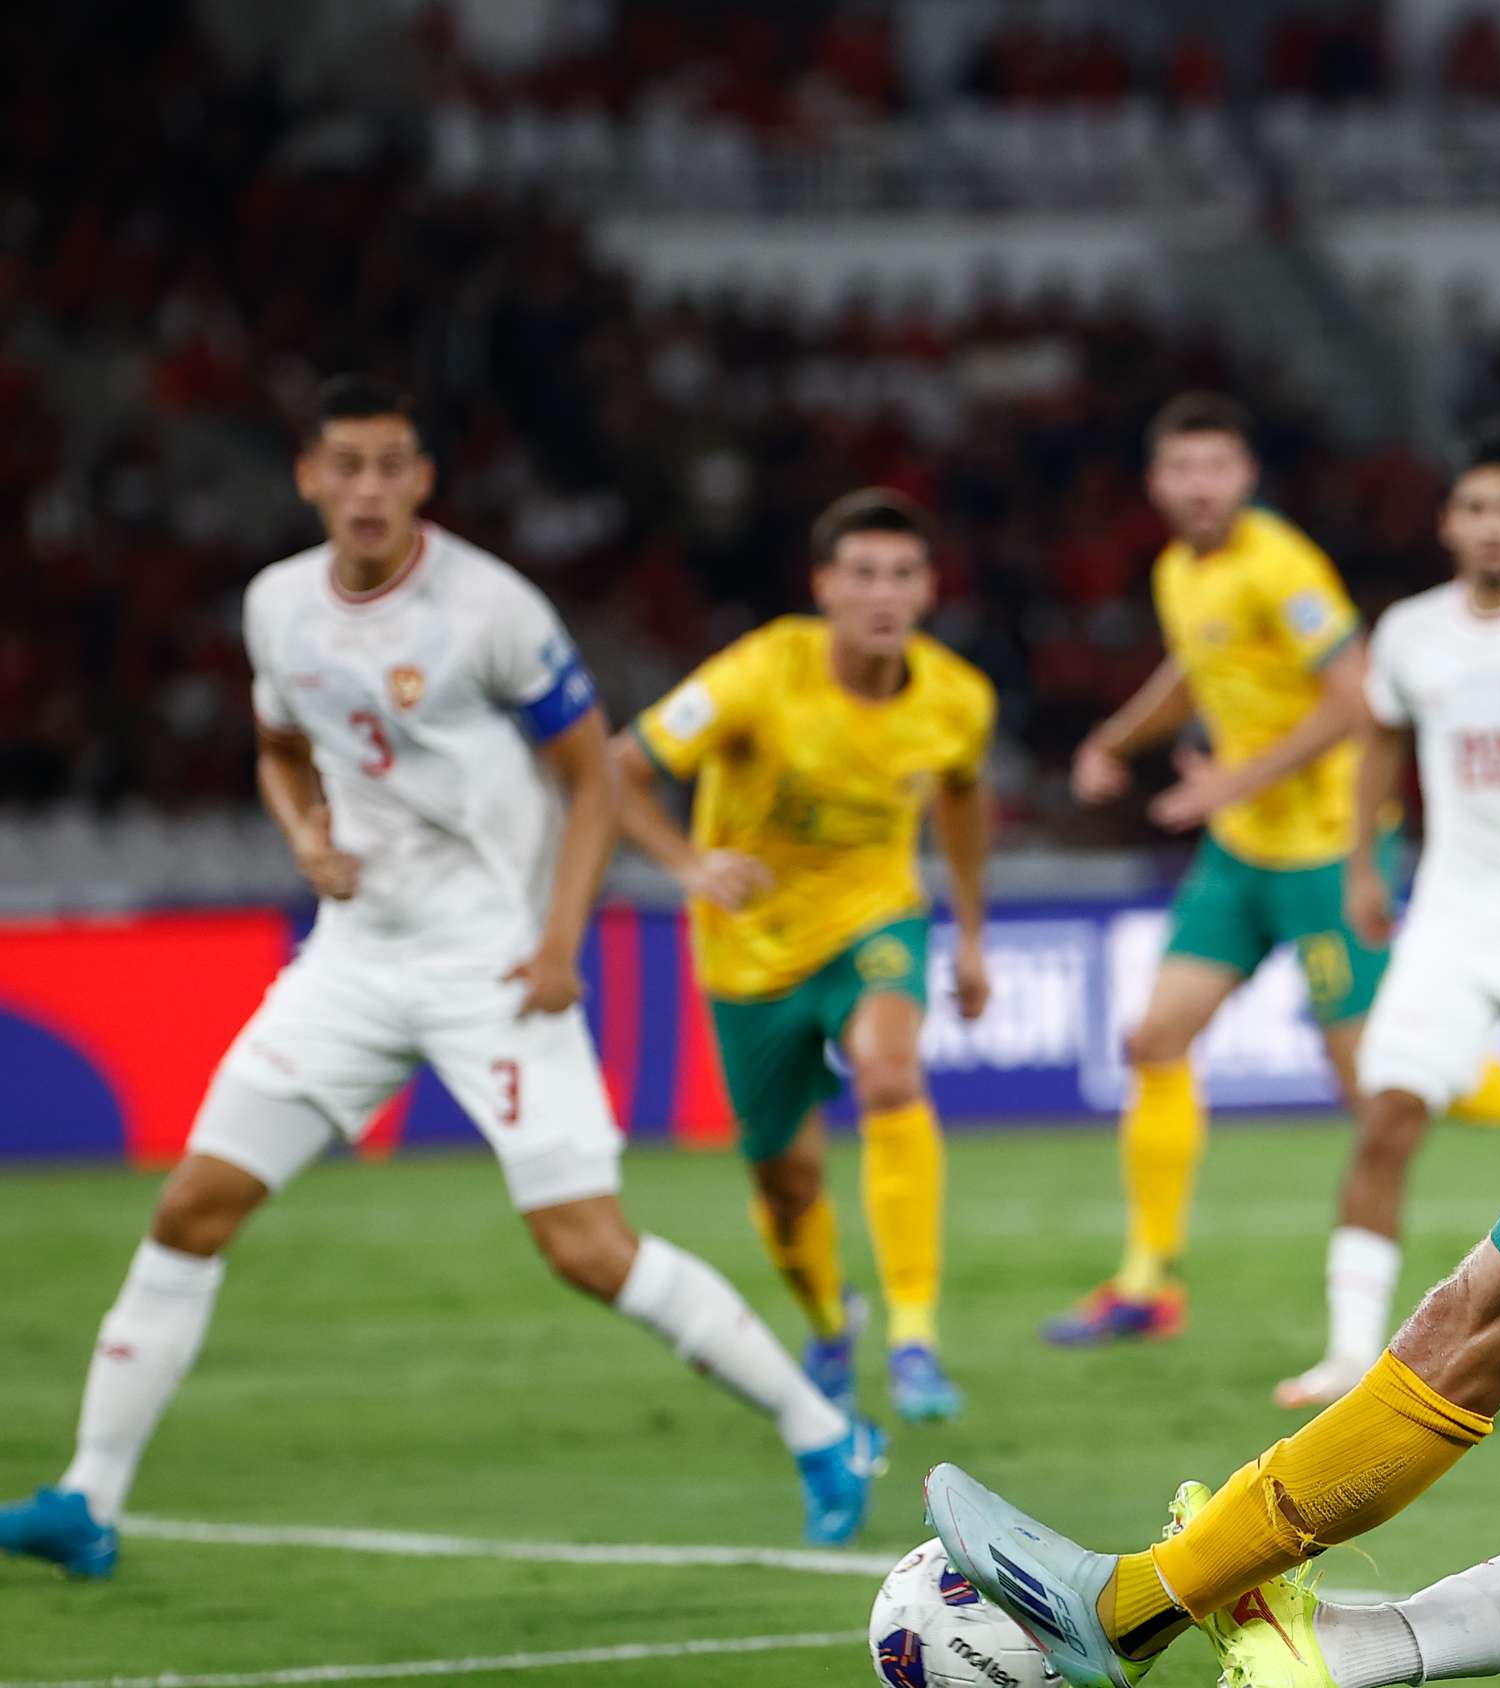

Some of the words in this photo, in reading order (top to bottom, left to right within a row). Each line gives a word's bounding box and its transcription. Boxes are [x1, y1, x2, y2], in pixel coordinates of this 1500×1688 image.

[348, 709, 396, 781] 3
[491, 1059, 522, 1127] 3
[948, 1636, 1021, 1688] molten
